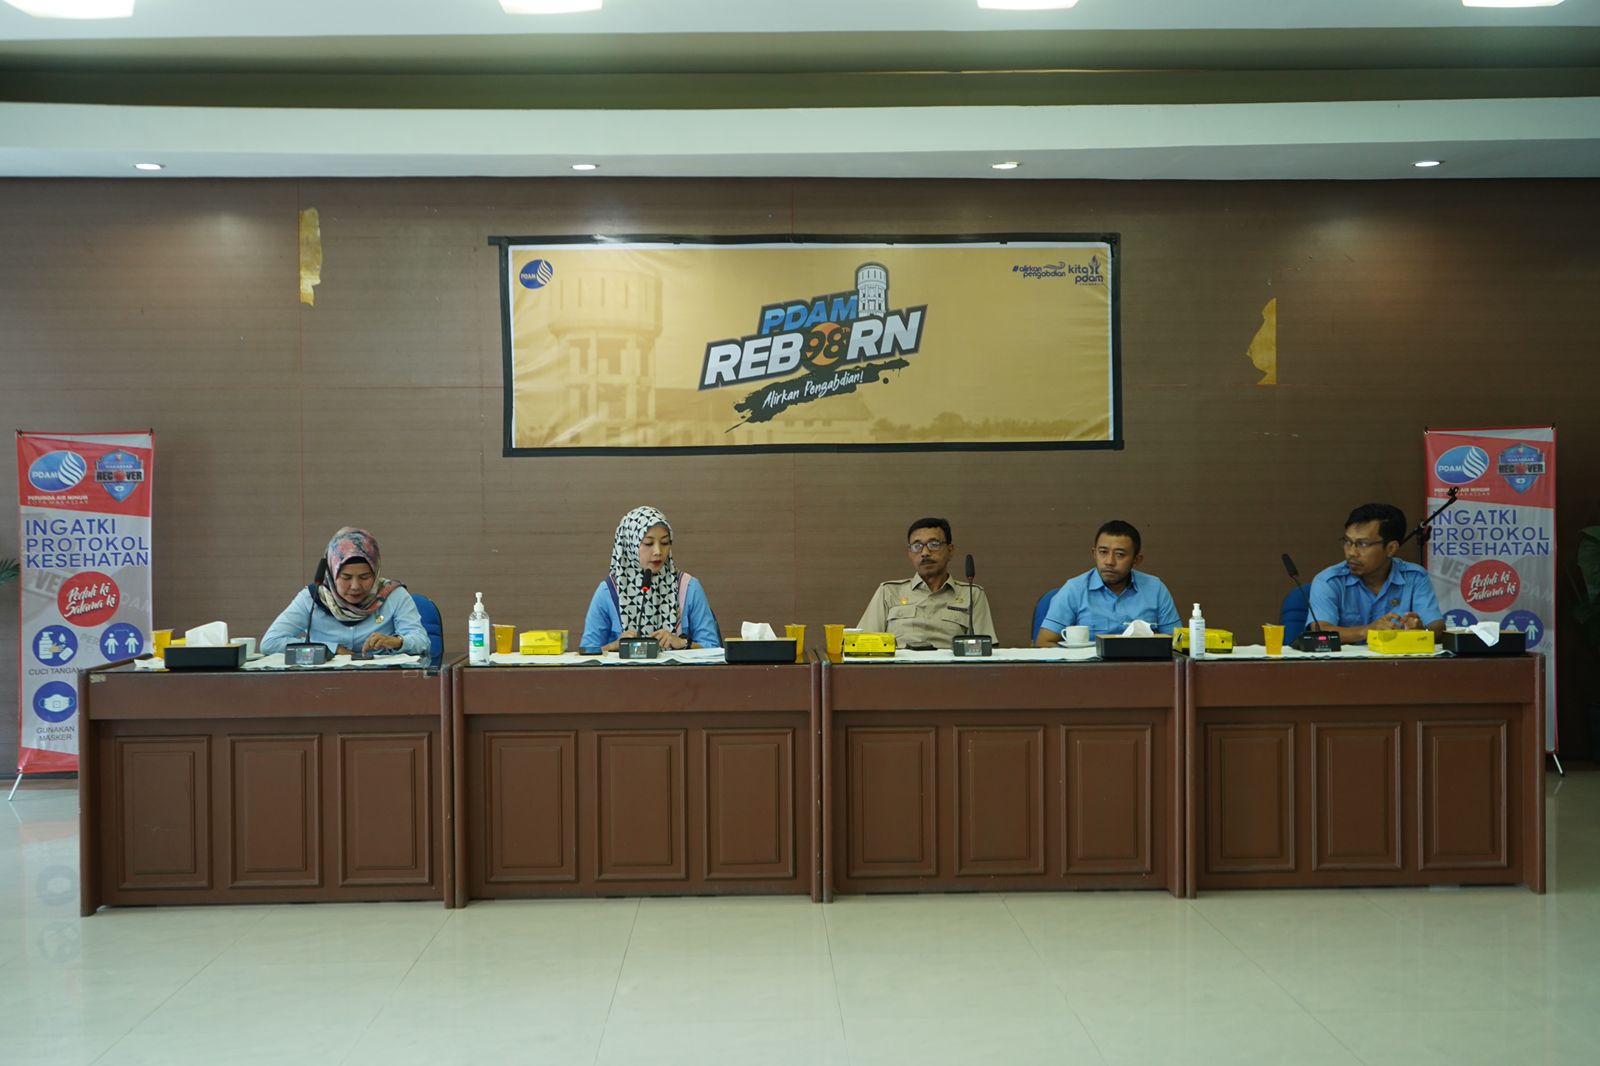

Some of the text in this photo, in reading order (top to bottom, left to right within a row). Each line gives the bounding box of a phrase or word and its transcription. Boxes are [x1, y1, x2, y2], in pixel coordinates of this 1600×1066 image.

[1075, 274, 1104, 284] pdam
[762, 295, 858, 335] PDAM
[762, 370, 864, 408] Alirkan Pengabdian!
[31, 471, 59, 479] PDAM
[1438, 465, 1463, 473] PDAM
[1432, 509, 1516, 525] INGATKI
[26, 518, 115, 536] INGATKI
[1433, 527, 1550, 541] PROTOKOL
[26, 536, 149, 552] PROTOKOL
[1433, 542, 1549, 556] KESEHATAN
[26, 552, 149, 568] KESEHATAN
[28, 668, 49, 676] CUCI
[36, 726, 75, 734] GUNAKAN
[39, 733, 72, 741] MASKER
